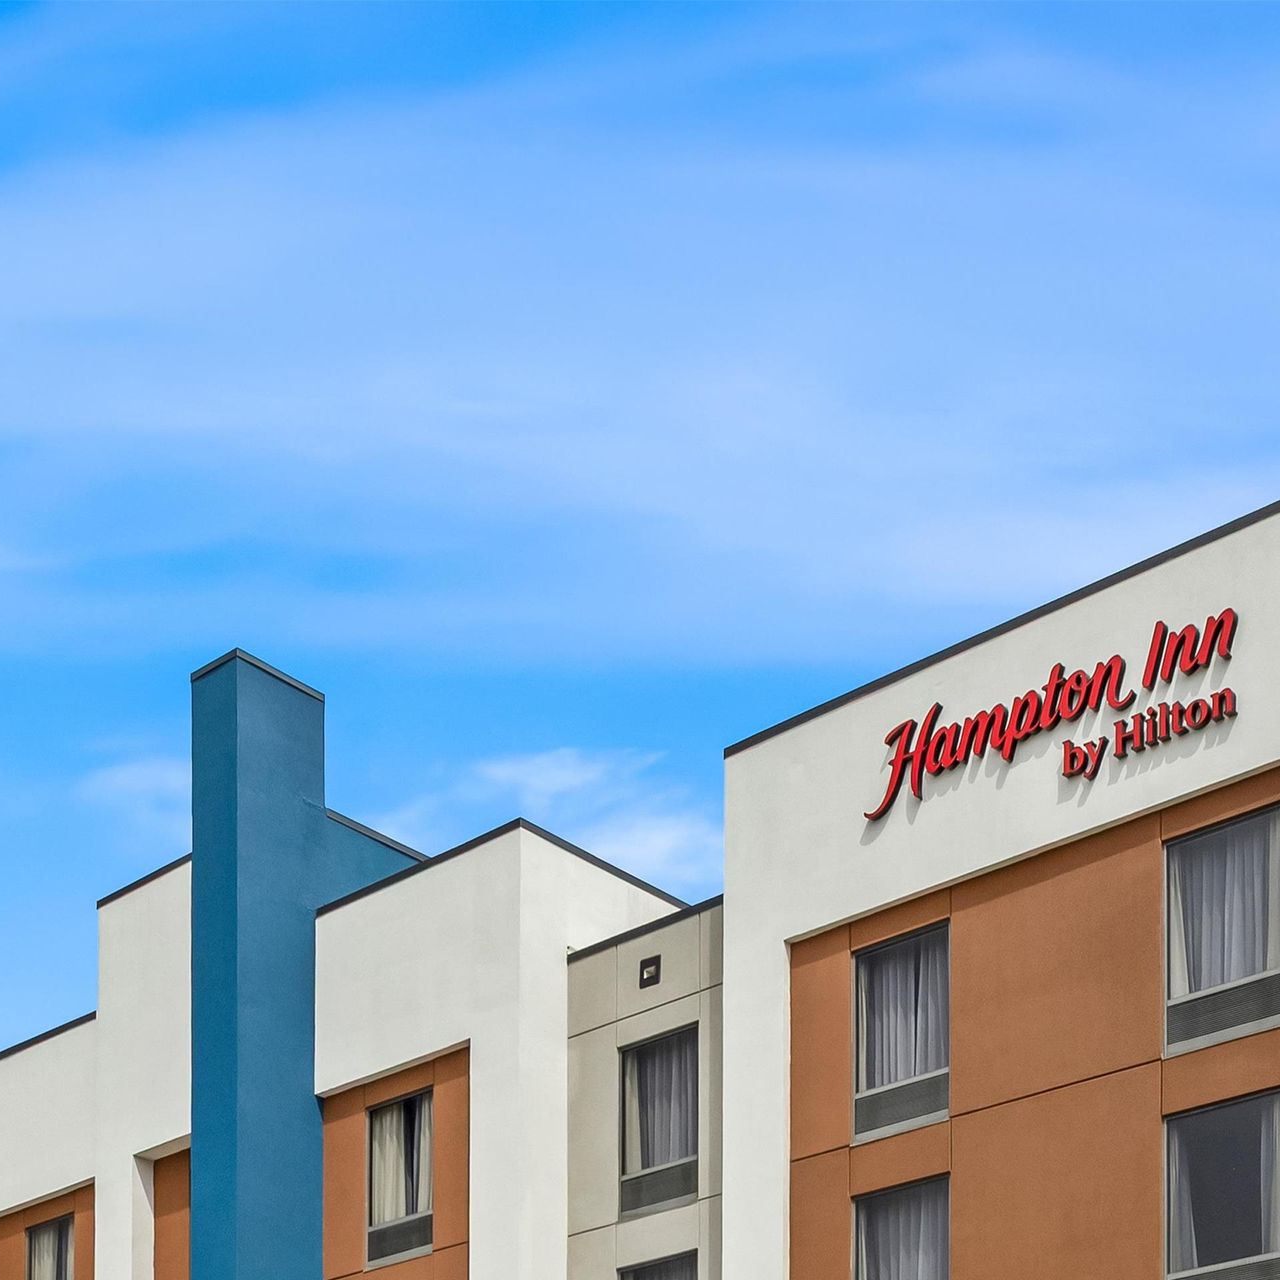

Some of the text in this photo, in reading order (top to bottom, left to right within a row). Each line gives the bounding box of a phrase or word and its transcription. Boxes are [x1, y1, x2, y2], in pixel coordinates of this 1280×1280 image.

[863, 607, 1238, 821] Hampton Inn
[1061, 687, 1238, 781] by Hilton
